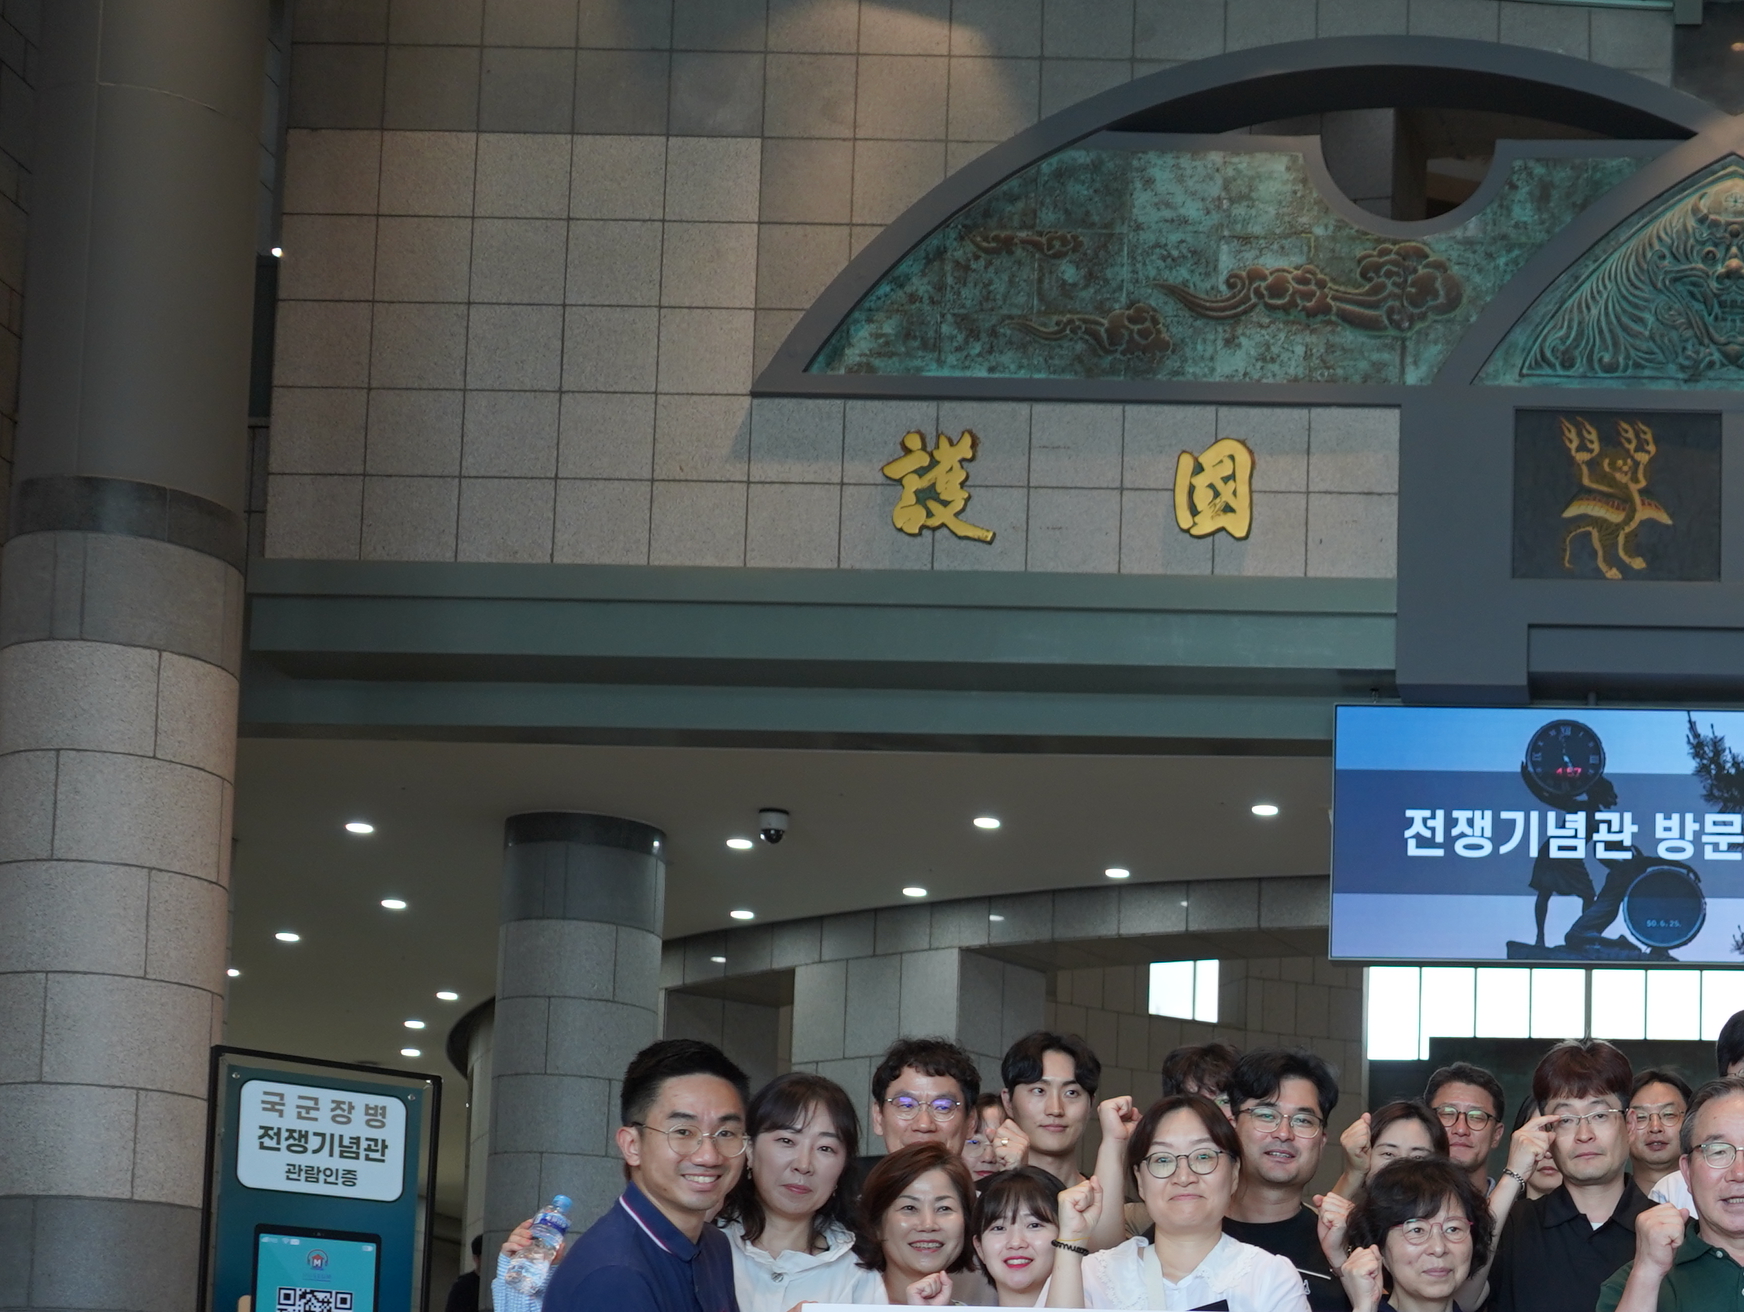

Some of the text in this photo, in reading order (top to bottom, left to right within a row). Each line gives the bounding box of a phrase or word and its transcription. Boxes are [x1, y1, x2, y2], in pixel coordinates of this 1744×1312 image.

[1404, 808, 1640, 860] 전쟁기념관
[257, 1124, 389, 1164] 전쟁기념관
[284, 1162, 359, 1188] 관람인증
